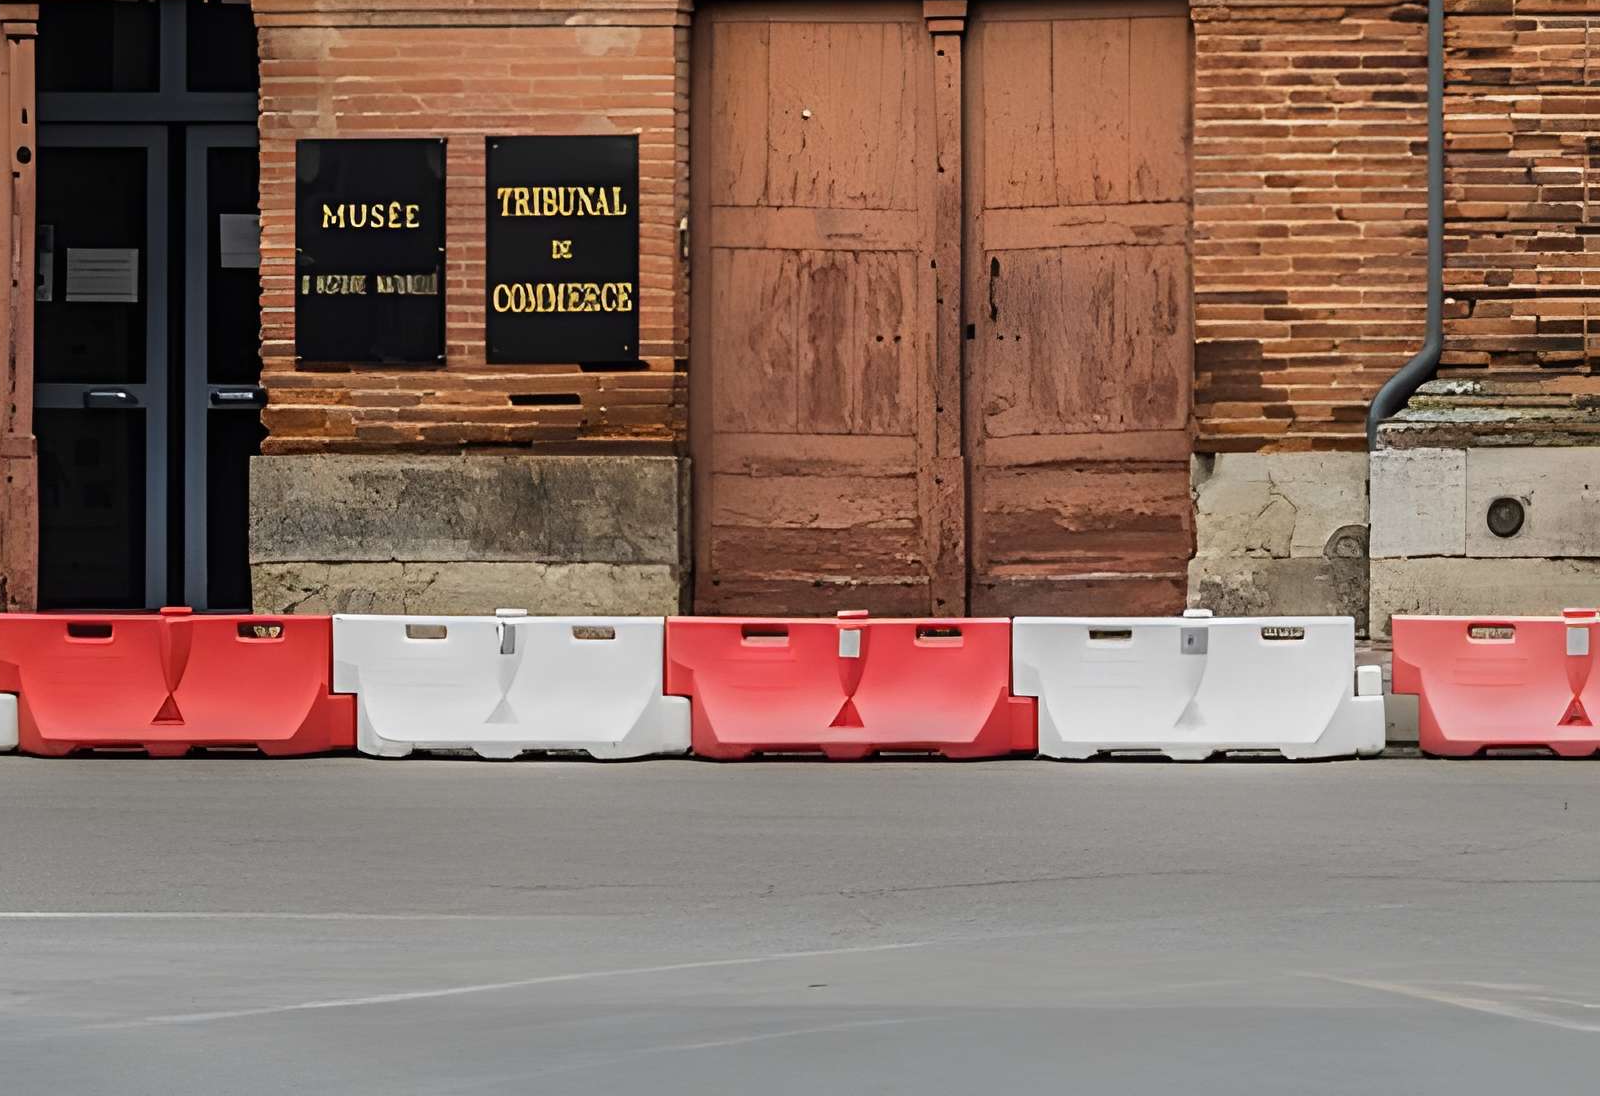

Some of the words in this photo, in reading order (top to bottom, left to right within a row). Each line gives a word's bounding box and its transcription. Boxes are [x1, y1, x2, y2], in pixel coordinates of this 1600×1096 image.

[497, 187, 627, 216] TRIBUNAL
[552, 240, 573, 259] DE
[493, 283, 632, 312] COMMERCE
